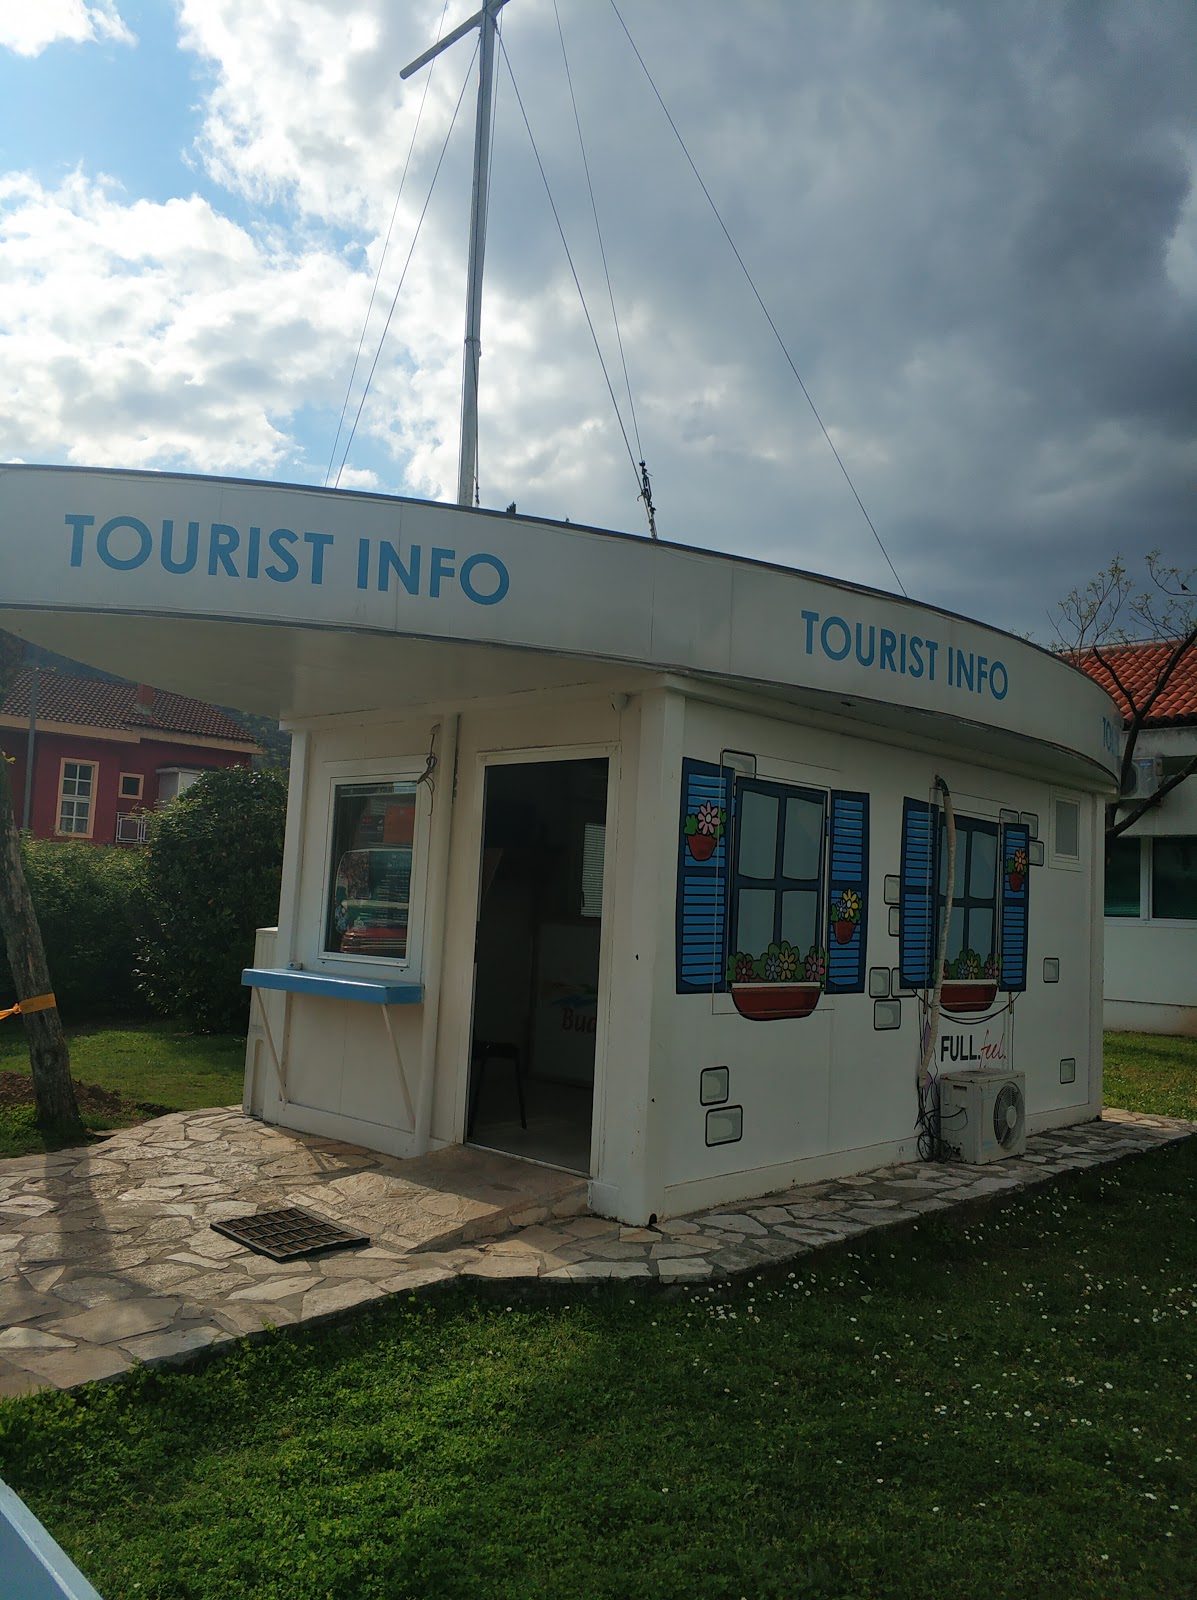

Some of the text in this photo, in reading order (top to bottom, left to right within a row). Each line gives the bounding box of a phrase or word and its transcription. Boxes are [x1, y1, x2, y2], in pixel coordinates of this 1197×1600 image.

[65, 513, 510, 606] TOURIST INFO
[801, 609, 1009, 701] TOURIST INFO
